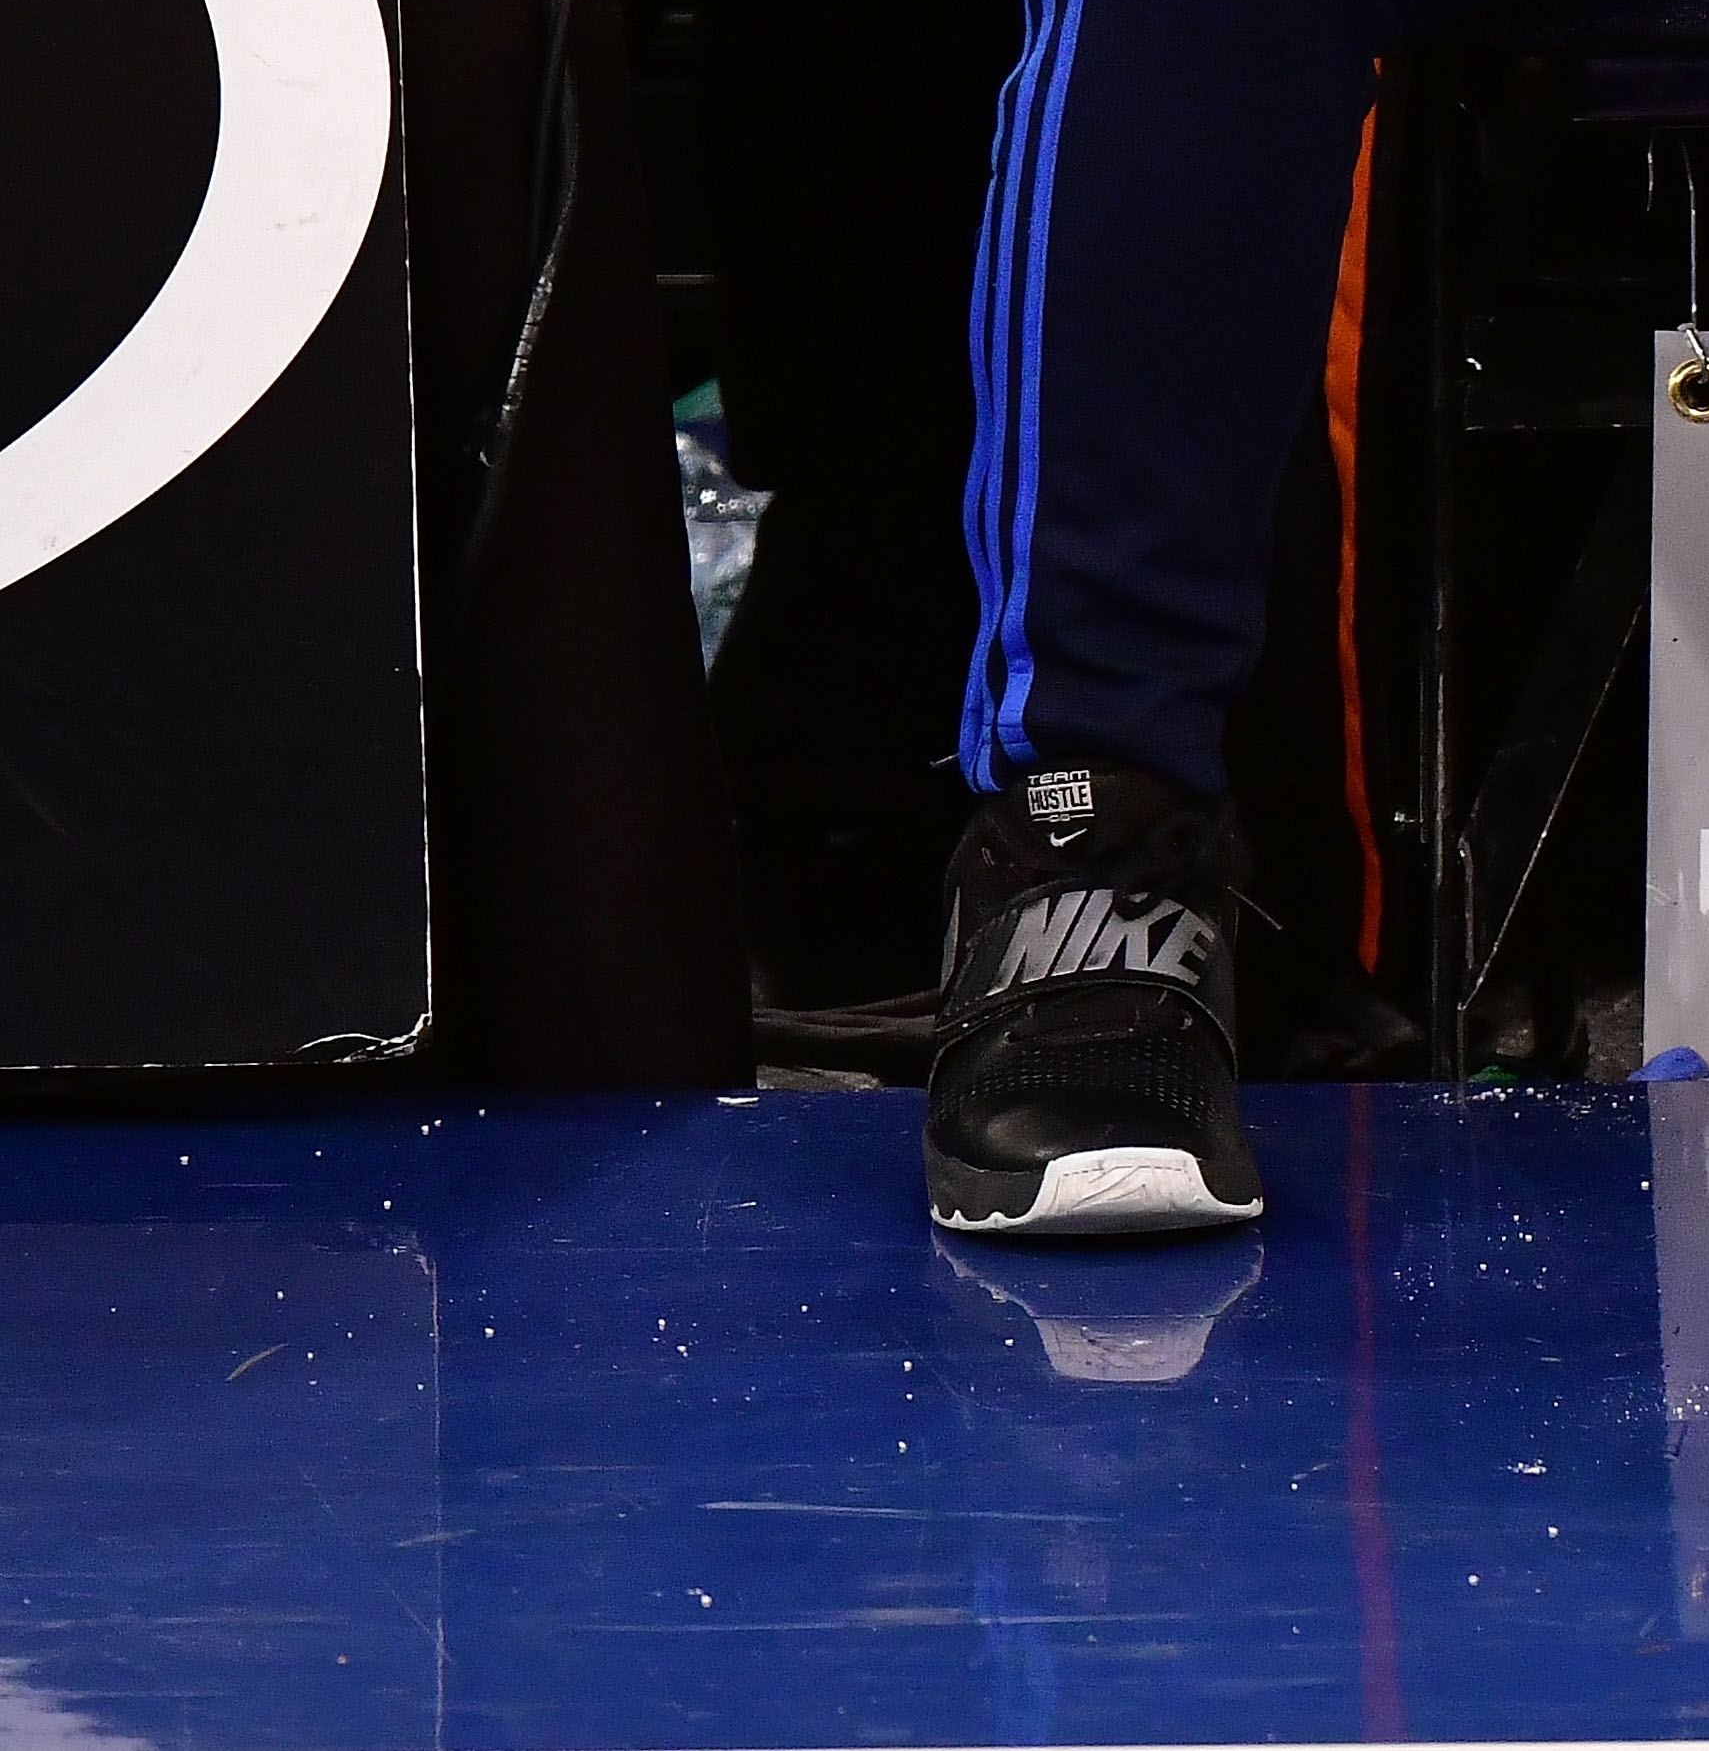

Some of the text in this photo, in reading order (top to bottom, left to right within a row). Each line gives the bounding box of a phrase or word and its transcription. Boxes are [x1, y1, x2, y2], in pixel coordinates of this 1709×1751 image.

[1027, 769, 1091, 785] TEAM
[1030, 784, 1090, 812] HUSTLE
[986, 888, 1217, 997] NIKE
